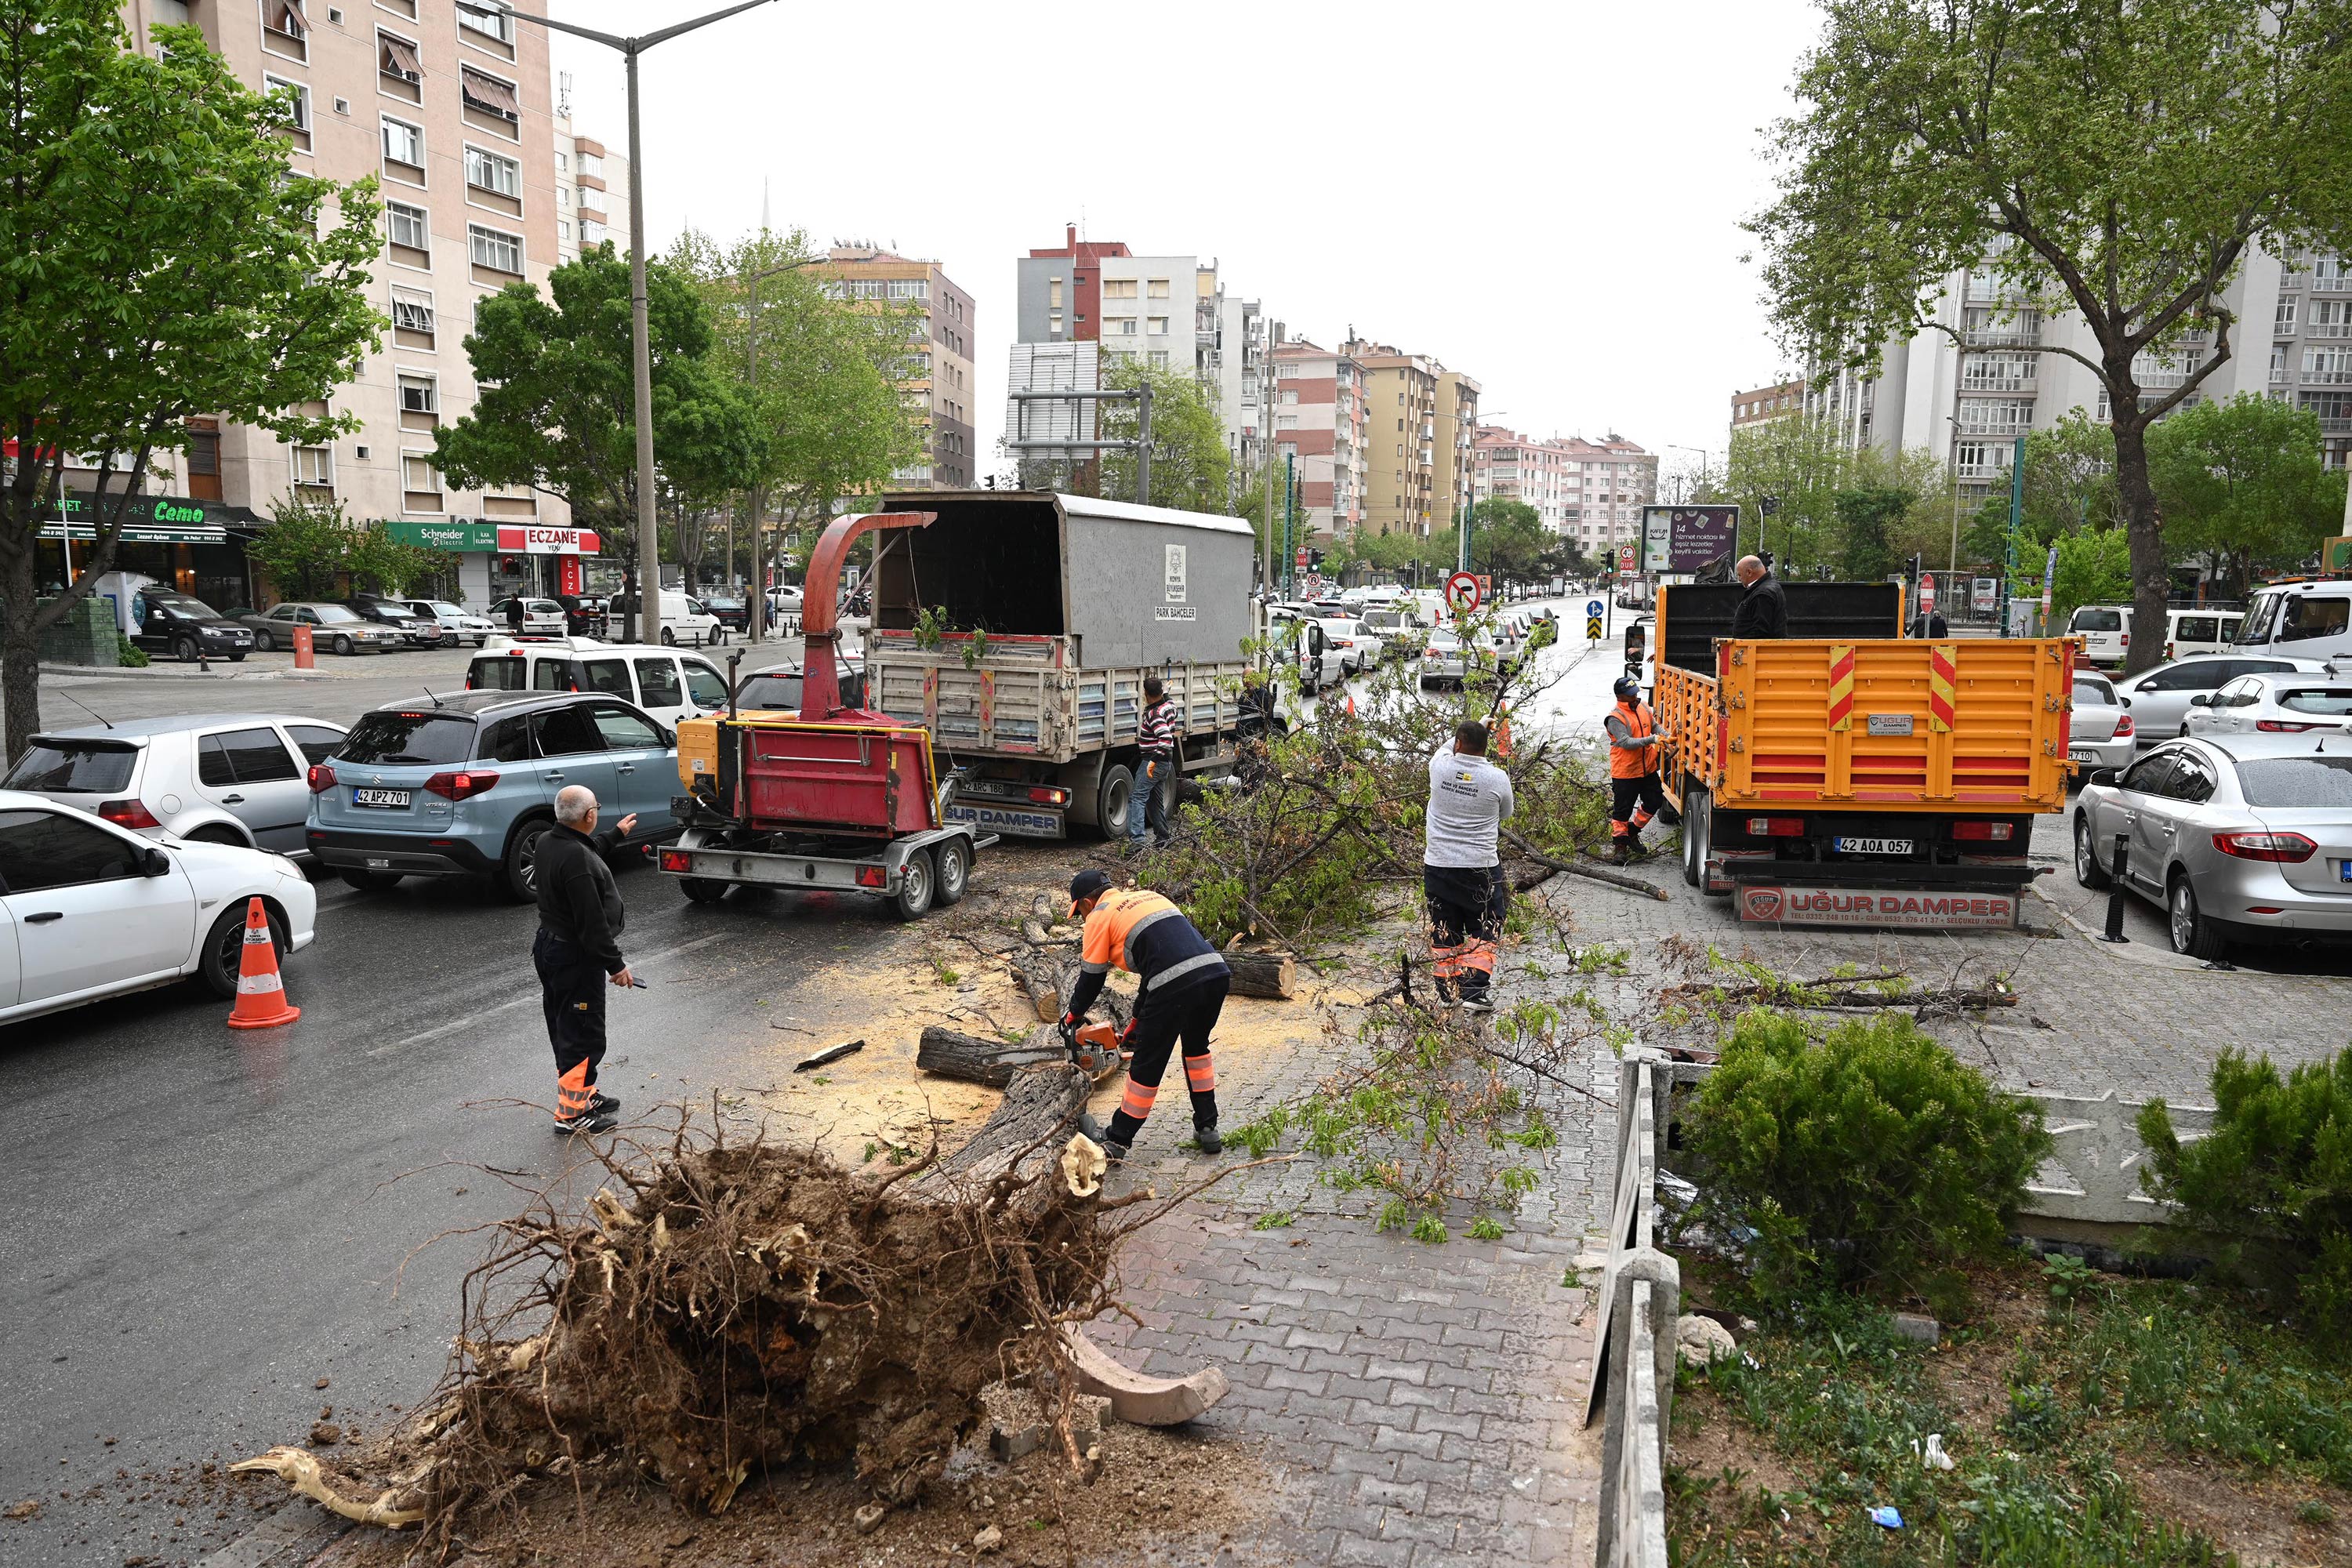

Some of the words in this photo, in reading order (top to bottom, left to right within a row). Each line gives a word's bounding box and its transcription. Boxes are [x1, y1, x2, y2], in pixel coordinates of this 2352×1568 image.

[154, 501, 204, 523] Cemo
[421, 528, 464, 539] Schneider
[528, 529, 577, 544] ECZANE
[1156, 608, 1169, 618] PARK
[1171, 608, 1195, 619] BAHÇELER
[973, 783, 987, 792] ARC
[989, 784, 1003, 793] 186
[358, 789, 368, 802] 42
[371, 791, 388, 803] APZ
[391, 792, 408, 804] 701
[980, 810, 1057, 829] DAMPER
[1841, 839, 1857, 851] 42
[1860, 840, 1883, 852] AOA
[1888, 840, 1911, 853] 057
[1116, 898, 1129, 912] PARK
[1791, 890, 1874, 913] UĞUR
[1879, 896, 2011, 916] DAMPER
